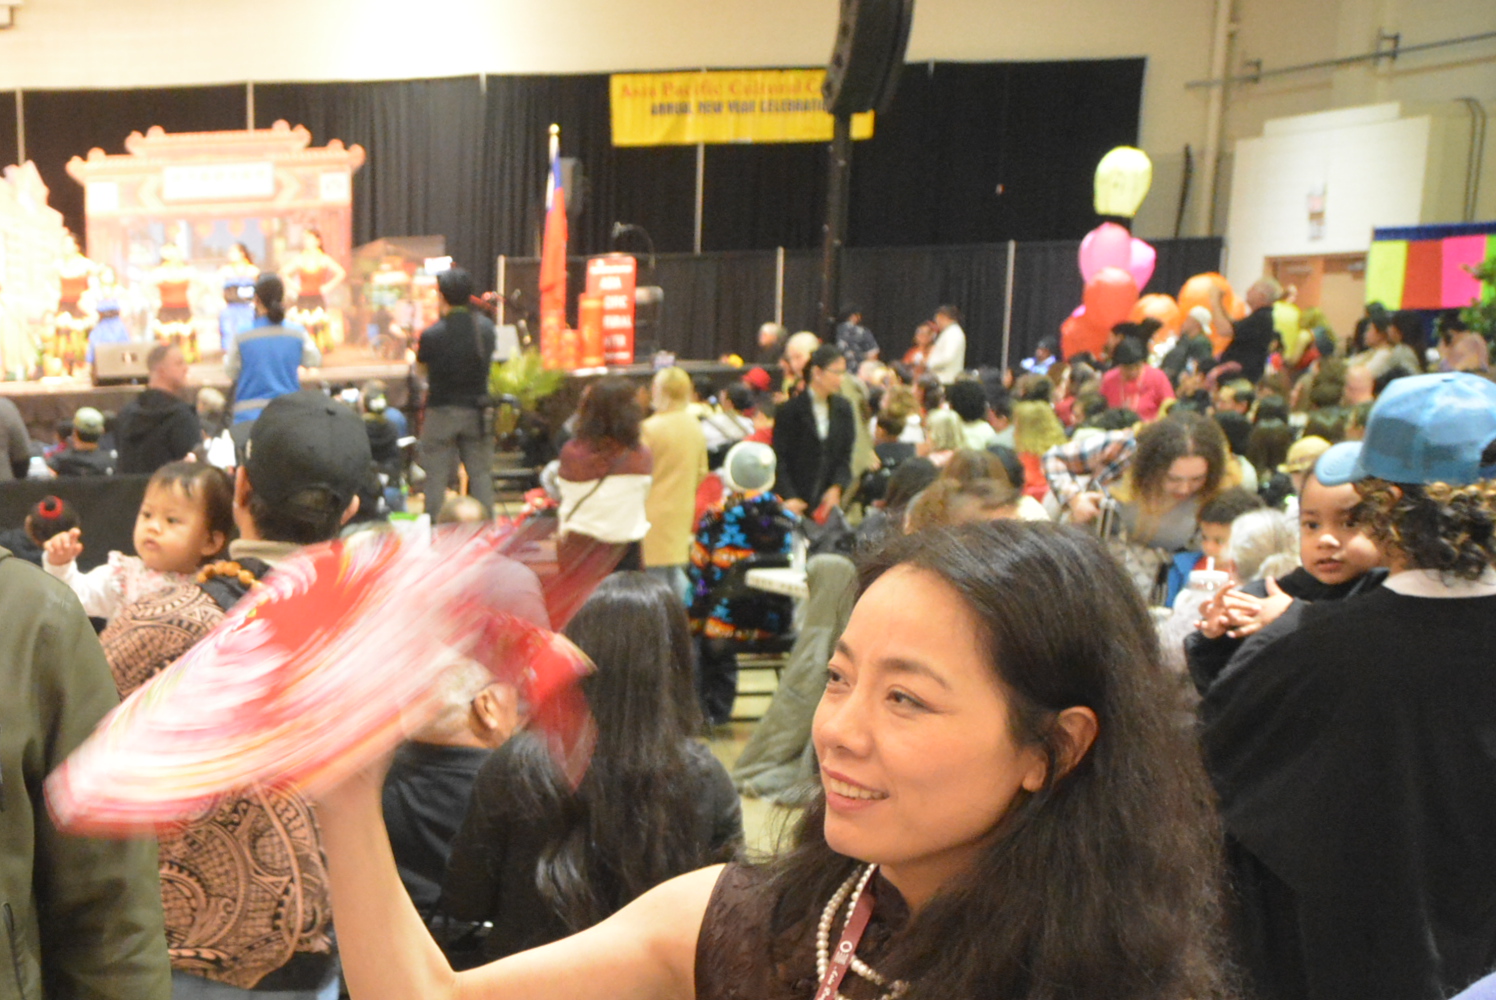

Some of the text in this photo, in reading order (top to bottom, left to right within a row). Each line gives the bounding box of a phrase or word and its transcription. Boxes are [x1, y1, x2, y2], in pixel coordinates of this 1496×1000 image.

[662, 79, 719, 97] Pacific
[699, 100, 723, 113] NEW
[728, 99, 756, 113] YEAR
[760, 97, 829, 113] CELEBRATI
